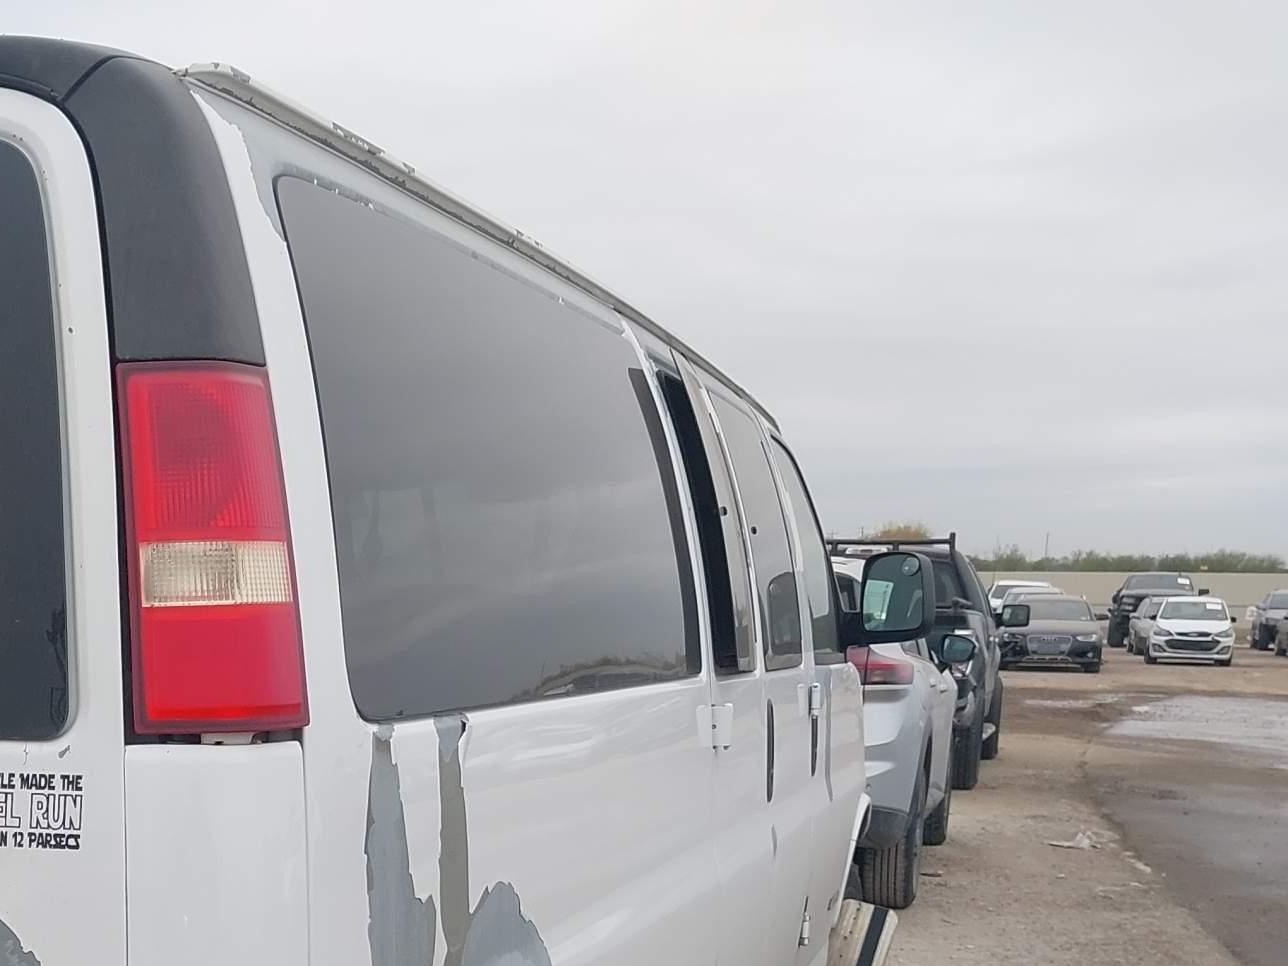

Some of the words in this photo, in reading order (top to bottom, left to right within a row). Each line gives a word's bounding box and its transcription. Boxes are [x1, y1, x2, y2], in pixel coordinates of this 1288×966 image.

[20, 772, 55, 790] MADE
[60, 774, 83, 791] THE
[30, 793, 83, 830] RUN
[12, 831, 24, 848] 12
[27, 832, 81, 850] PARSECS
